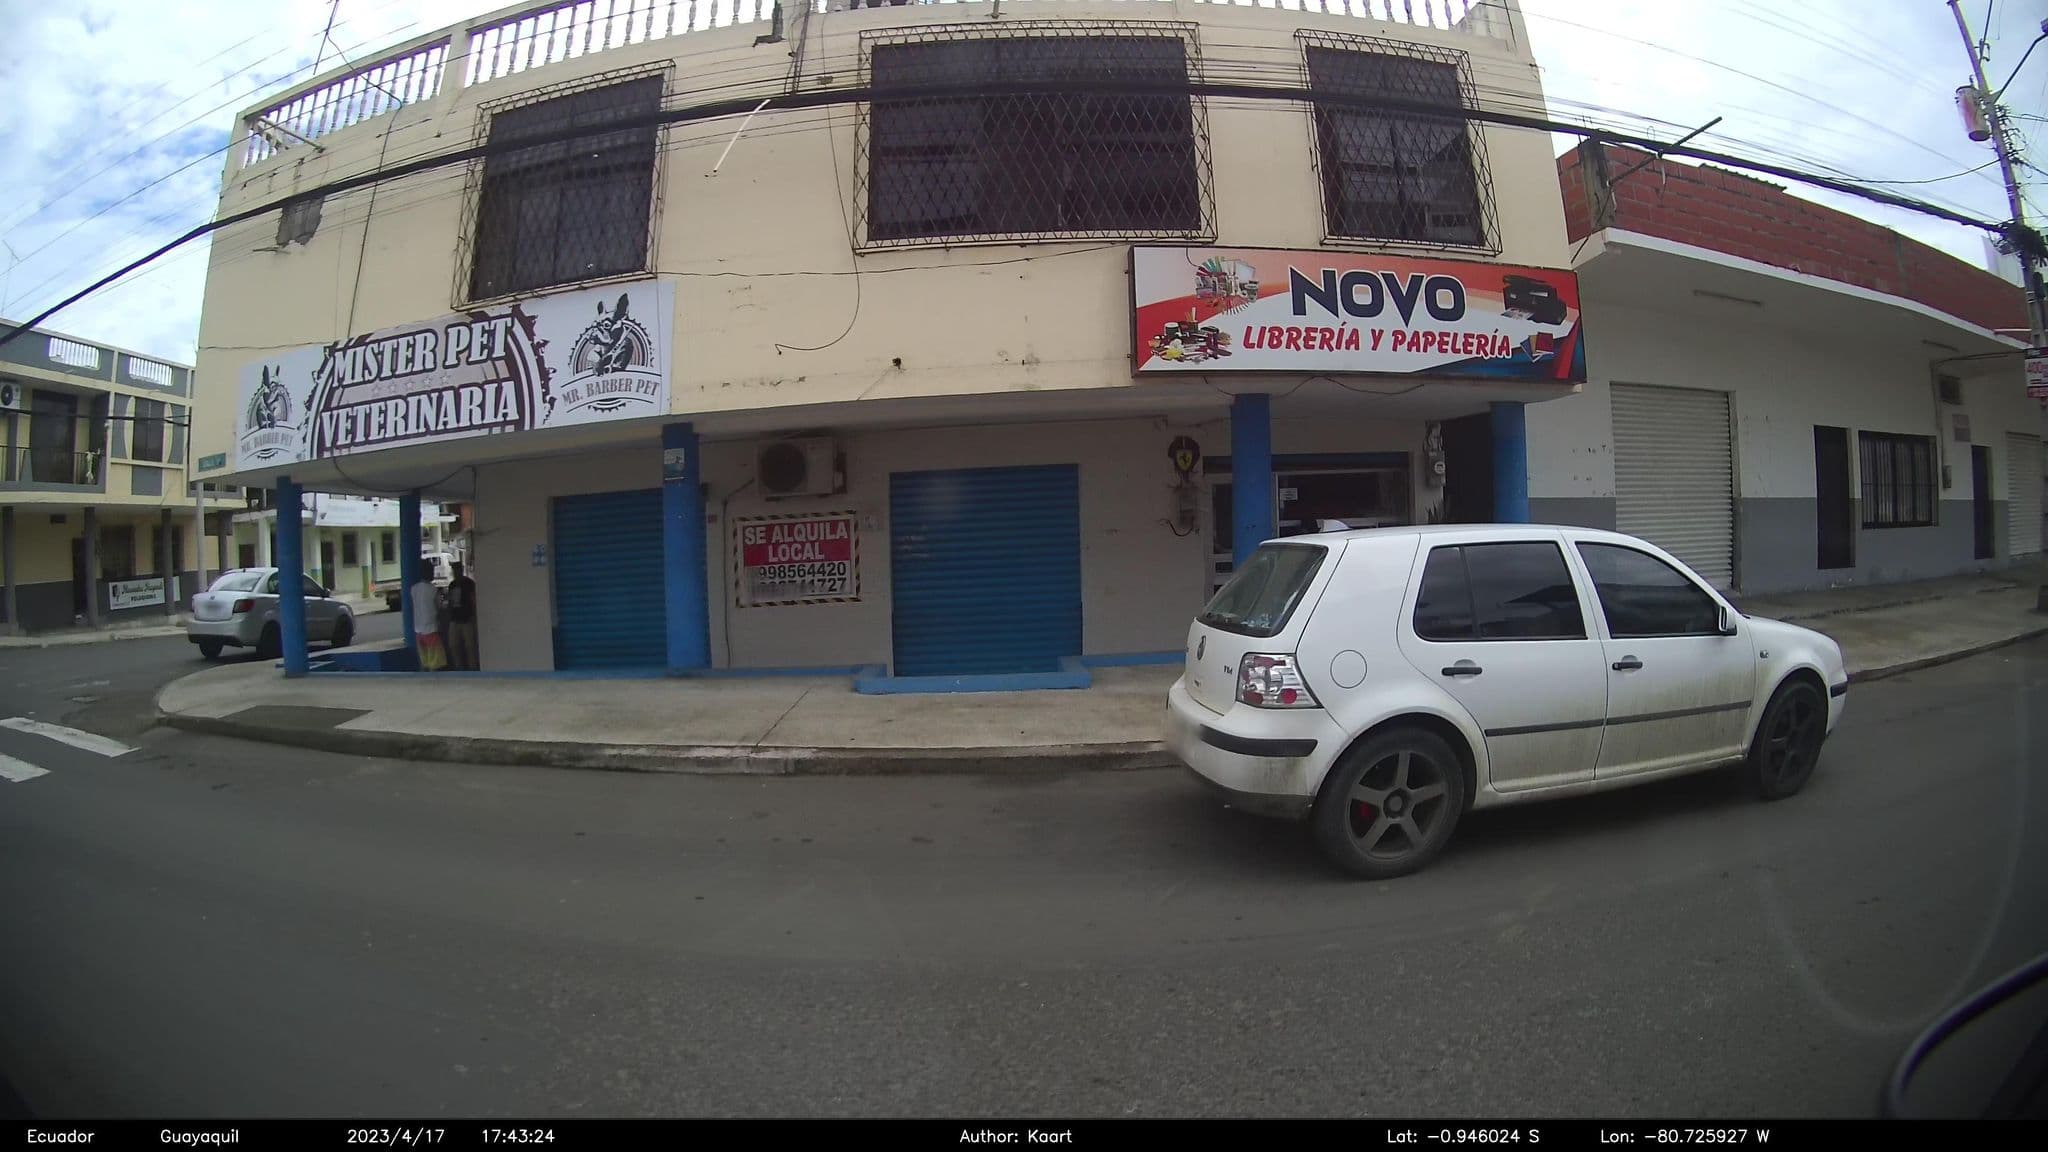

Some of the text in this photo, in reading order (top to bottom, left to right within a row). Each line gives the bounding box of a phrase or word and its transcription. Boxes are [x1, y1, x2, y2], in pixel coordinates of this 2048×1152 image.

[1290, 267, 1466, 327] NOVO
[332, 317, 514, 388] MISTER PET
[1243, 321, 1512, 359] LIBRERÍA Y PAPELERÍA
[562, 378, 660, 405] MR. BARBER PET
[321, 381, 519, 448] VETERINARIA
[744, 521, 848, 545] SE ALQUILA
[768, 543, 825, 562] LOCAL
